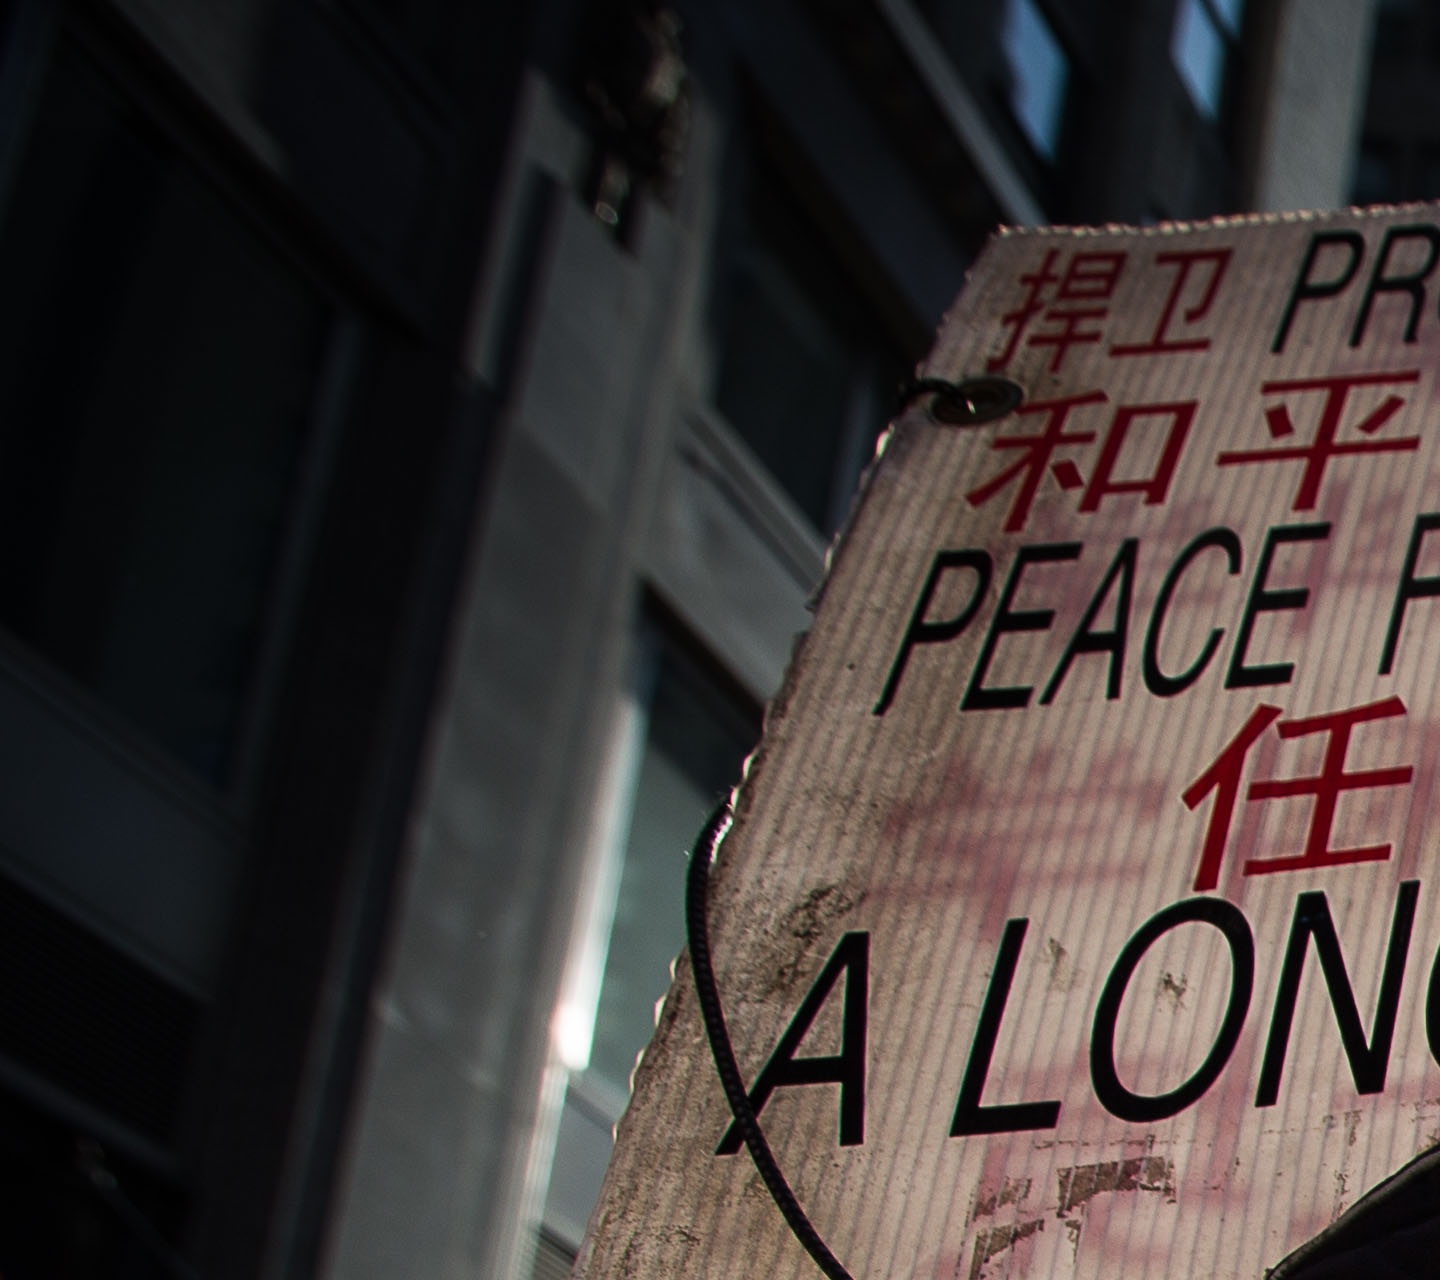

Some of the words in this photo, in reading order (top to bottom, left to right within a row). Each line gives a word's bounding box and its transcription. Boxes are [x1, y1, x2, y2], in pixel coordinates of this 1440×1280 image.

[992, 246, 1233, 372] 捍卫
[965, 369, 1421, 533] 和平
[872, 522, 1333, 716] PEACE
[713, 930, 872, 1156] A
